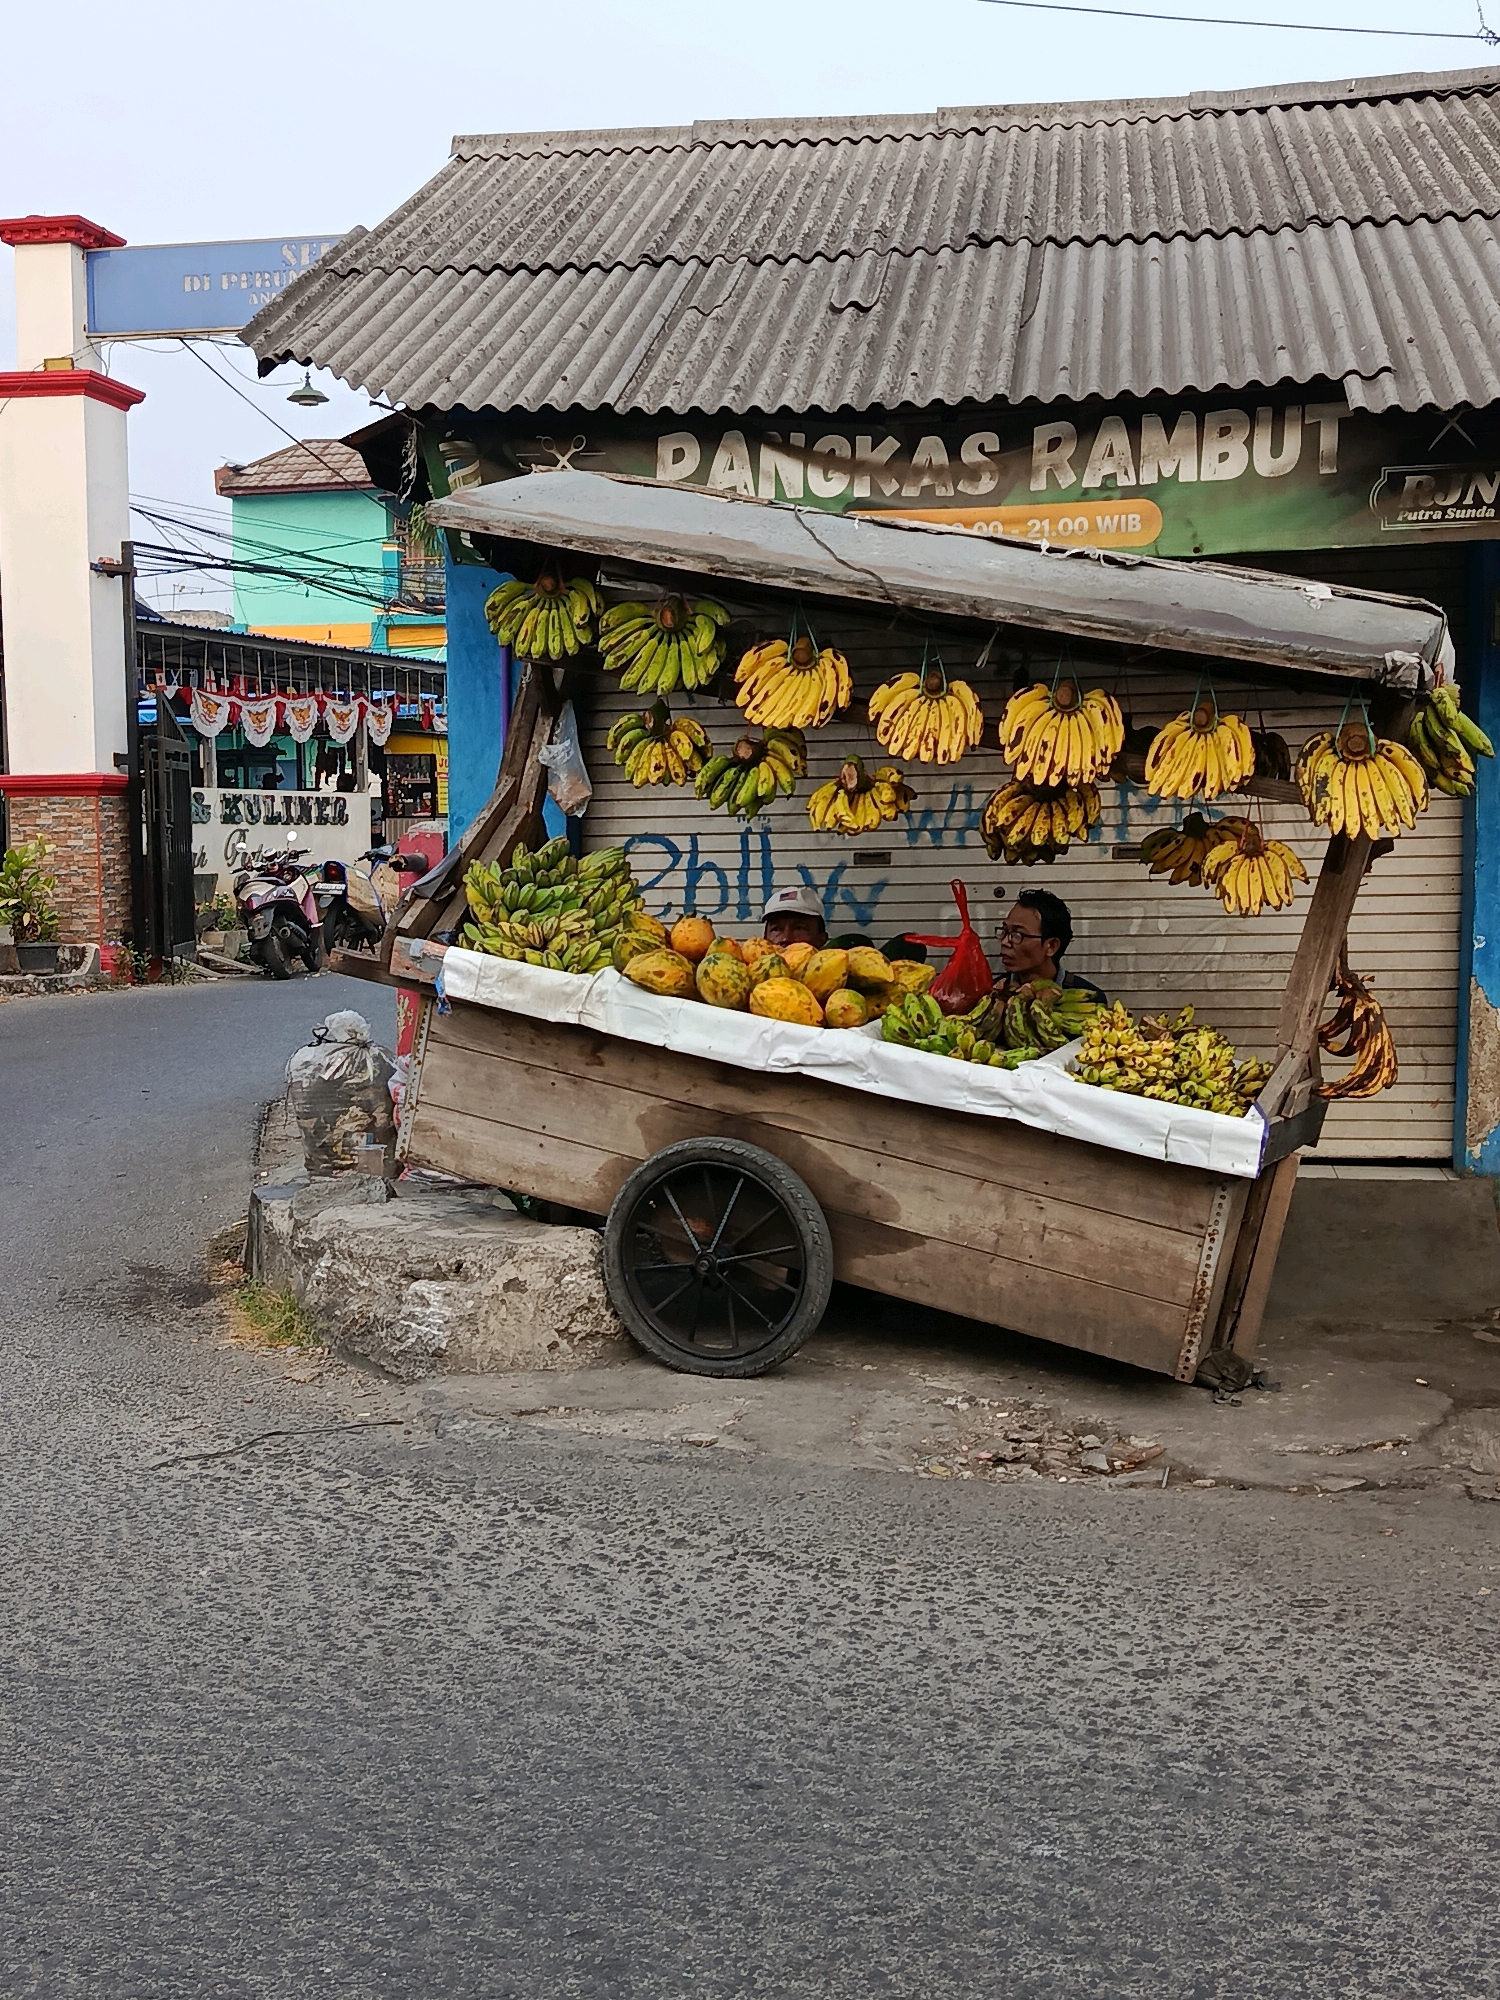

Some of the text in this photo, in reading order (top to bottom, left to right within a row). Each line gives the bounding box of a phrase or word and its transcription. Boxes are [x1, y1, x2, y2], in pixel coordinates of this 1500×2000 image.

[184, 273, 211, 292] DI
[249, 291, 278, 305] AN
[656, 403, 1354, 499] PANGKAS RAMBUT
[1398, 471, 1500, 508] RJN
[1026, 517, 1089, 538] 21.00
[1095, 513, 1142, 534] WIB
[1397, 506, 1496, 521] Putra Sunda
[220, 793, 349, 826] KULINER
